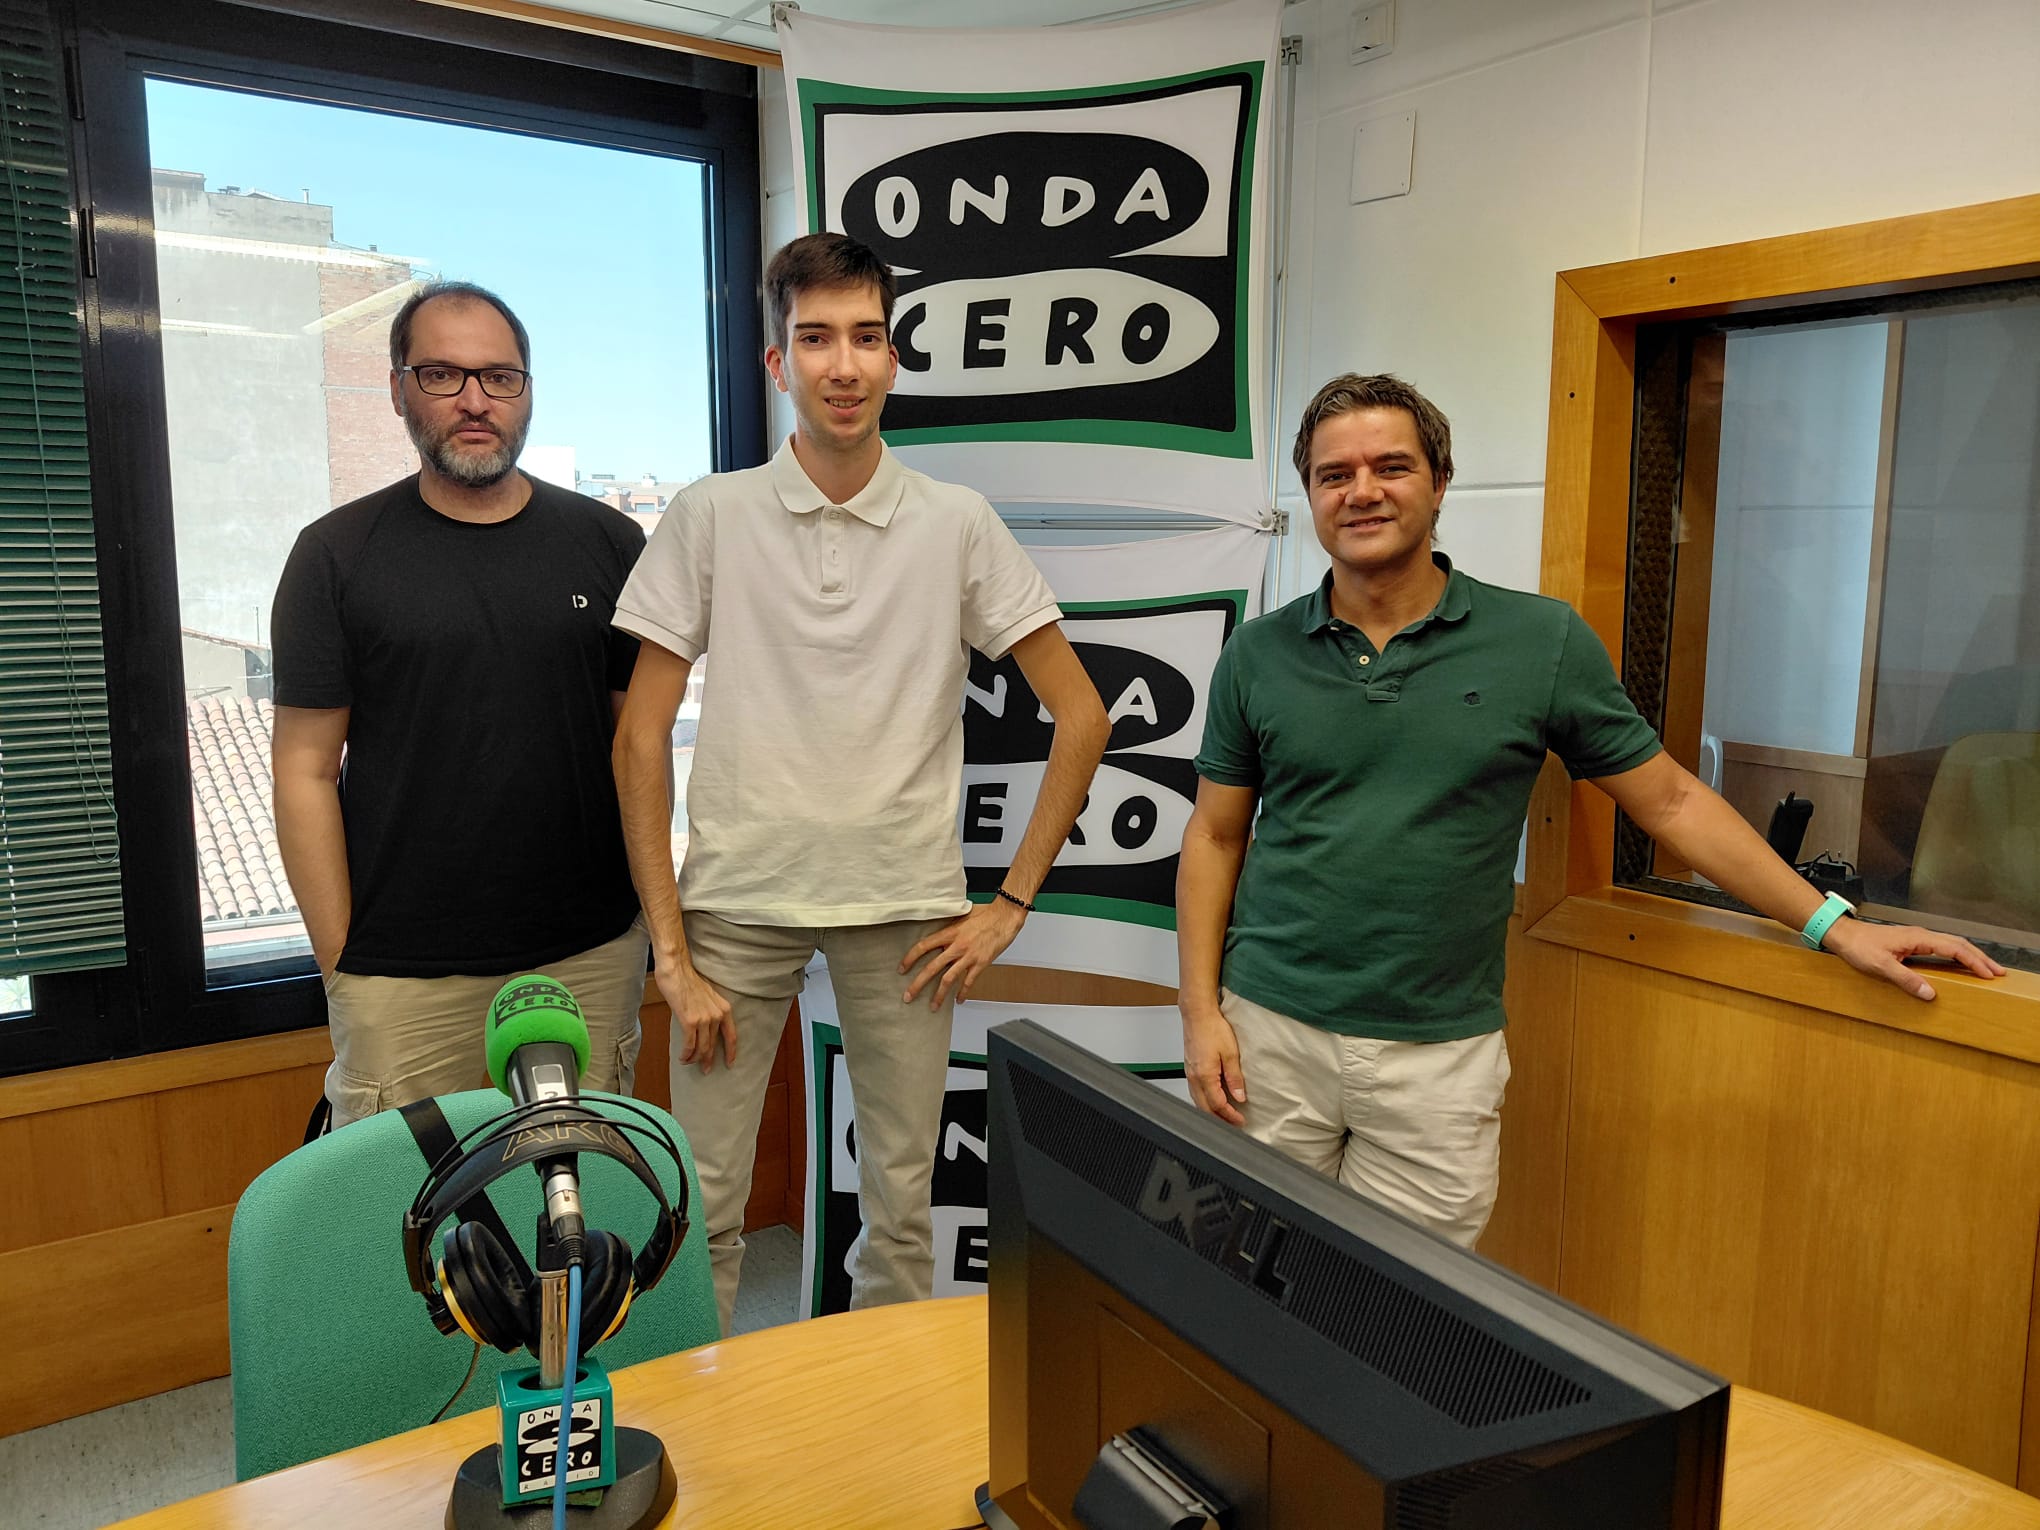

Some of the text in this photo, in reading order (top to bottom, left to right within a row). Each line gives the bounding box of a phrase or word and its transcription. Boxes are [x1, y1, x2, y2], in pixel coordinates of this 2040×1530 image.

[874, 168, 1170, 238] ONDA
[891, 297, 1171, 372] CERO
[960, 674, 1159, 726] NA
[504, 986, 567, 1002] ONDA
[508, 997, 569, 1011] CERO
[527, 1403, 593, 1425] ONA
[523, 1470, 595, 1491] RAIO
